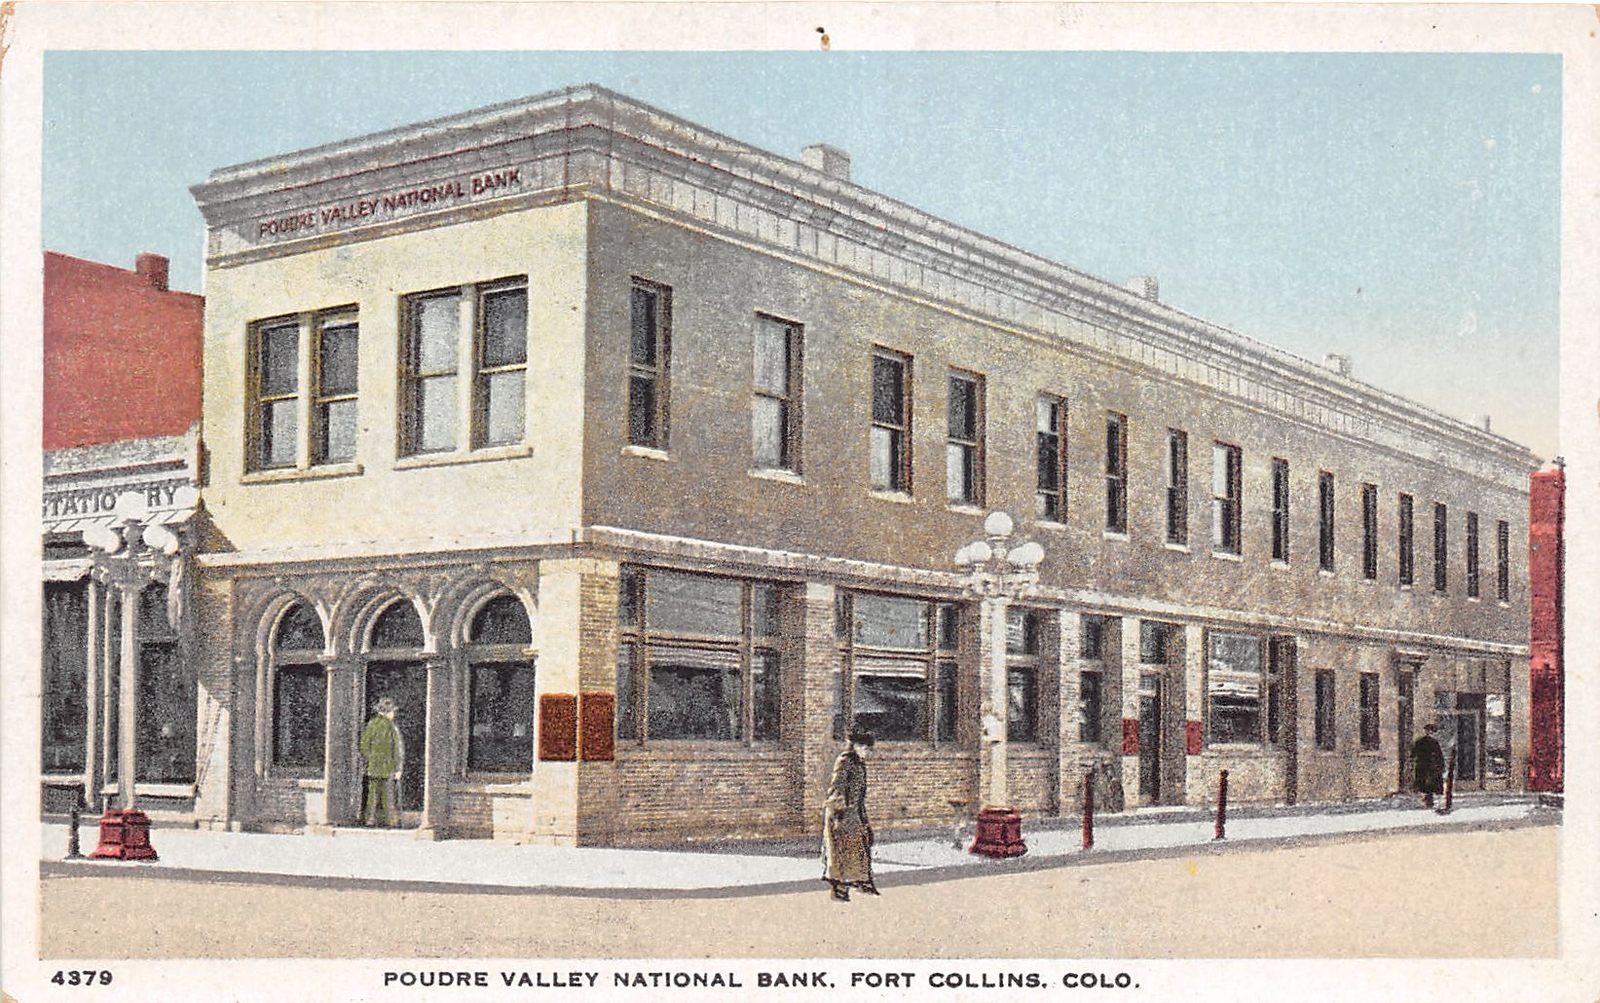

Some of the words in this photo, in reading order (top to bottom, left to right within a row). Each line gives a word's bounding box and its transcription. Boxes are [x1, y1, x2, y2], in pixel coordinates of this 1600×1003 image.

[259, 211, 315, 237] POUDRE
[320, 197, 378, 224] VALLEY
[382, 181, 465, 211] NATIONAL
[471, 167, 520, 195] BANK
